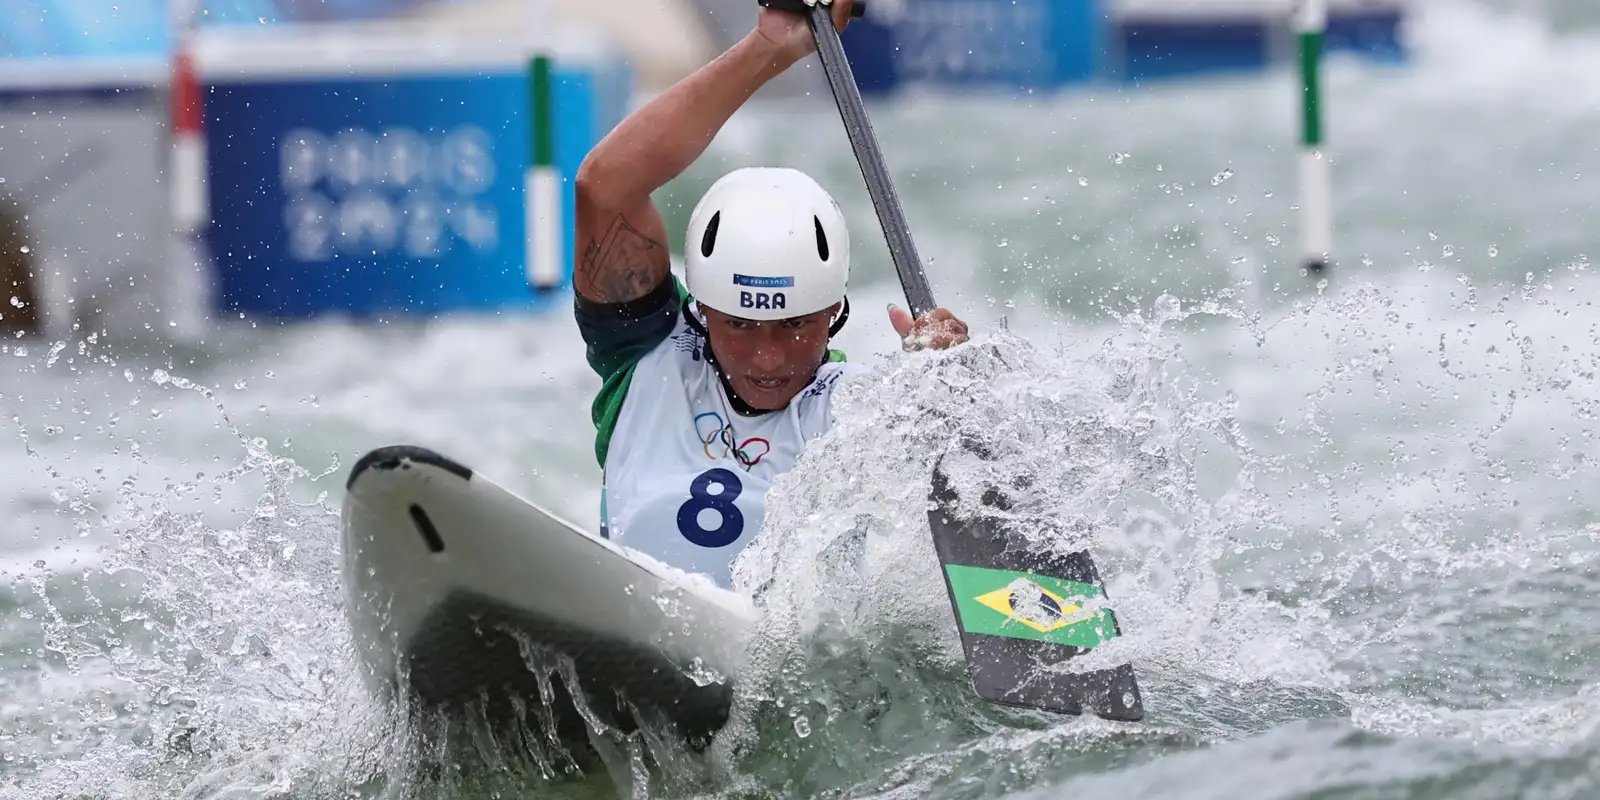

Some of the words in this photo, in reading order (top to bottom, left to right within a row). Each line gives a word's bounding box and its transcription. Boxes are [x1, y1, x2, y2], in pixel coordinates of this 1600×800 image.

[279, 128, 495, 194] PARIS
[285, 194, 497, 259] 2024
[740, 291, 786, 309] BRA
[677, 468, 744, 548] 8
